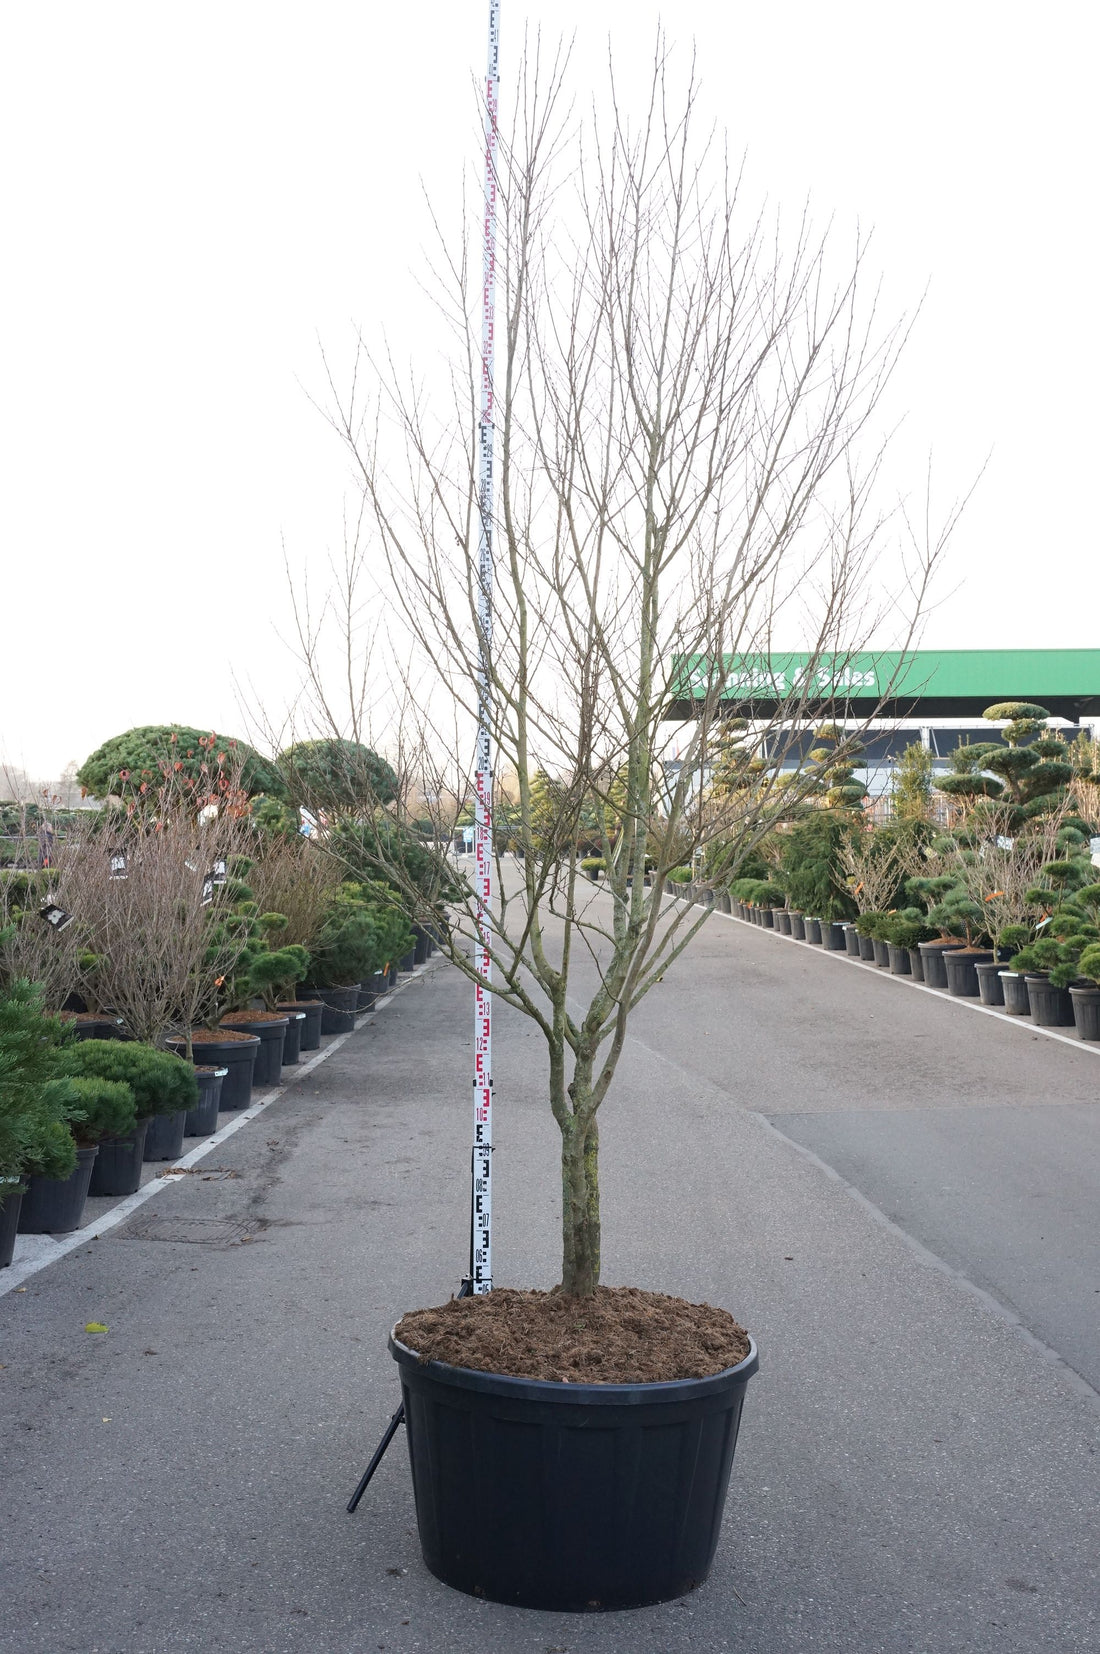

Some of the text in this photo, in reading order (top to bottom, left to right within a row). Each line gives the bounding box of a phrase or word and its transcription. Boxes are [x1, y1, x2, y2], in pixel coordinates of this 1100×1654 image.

[815, 667, 875, 687] Sales
[483, 791, 491, 805] 19
[477, 827, 483, 840] 18
[483, 861, 490, 875] 17
[483, 931, 490, 945] 15
[483, 1002, 490, 1015] 13
[476, 1037, 483, 1050] 12
[483, 1072, 490, 1086] 11
[476, 1107, 483, 1121] 10
[476, 1179, 482, 1192] 08
[482, 1213, 489, 1227] 07
[476, 1249, 482, 1262] 06
